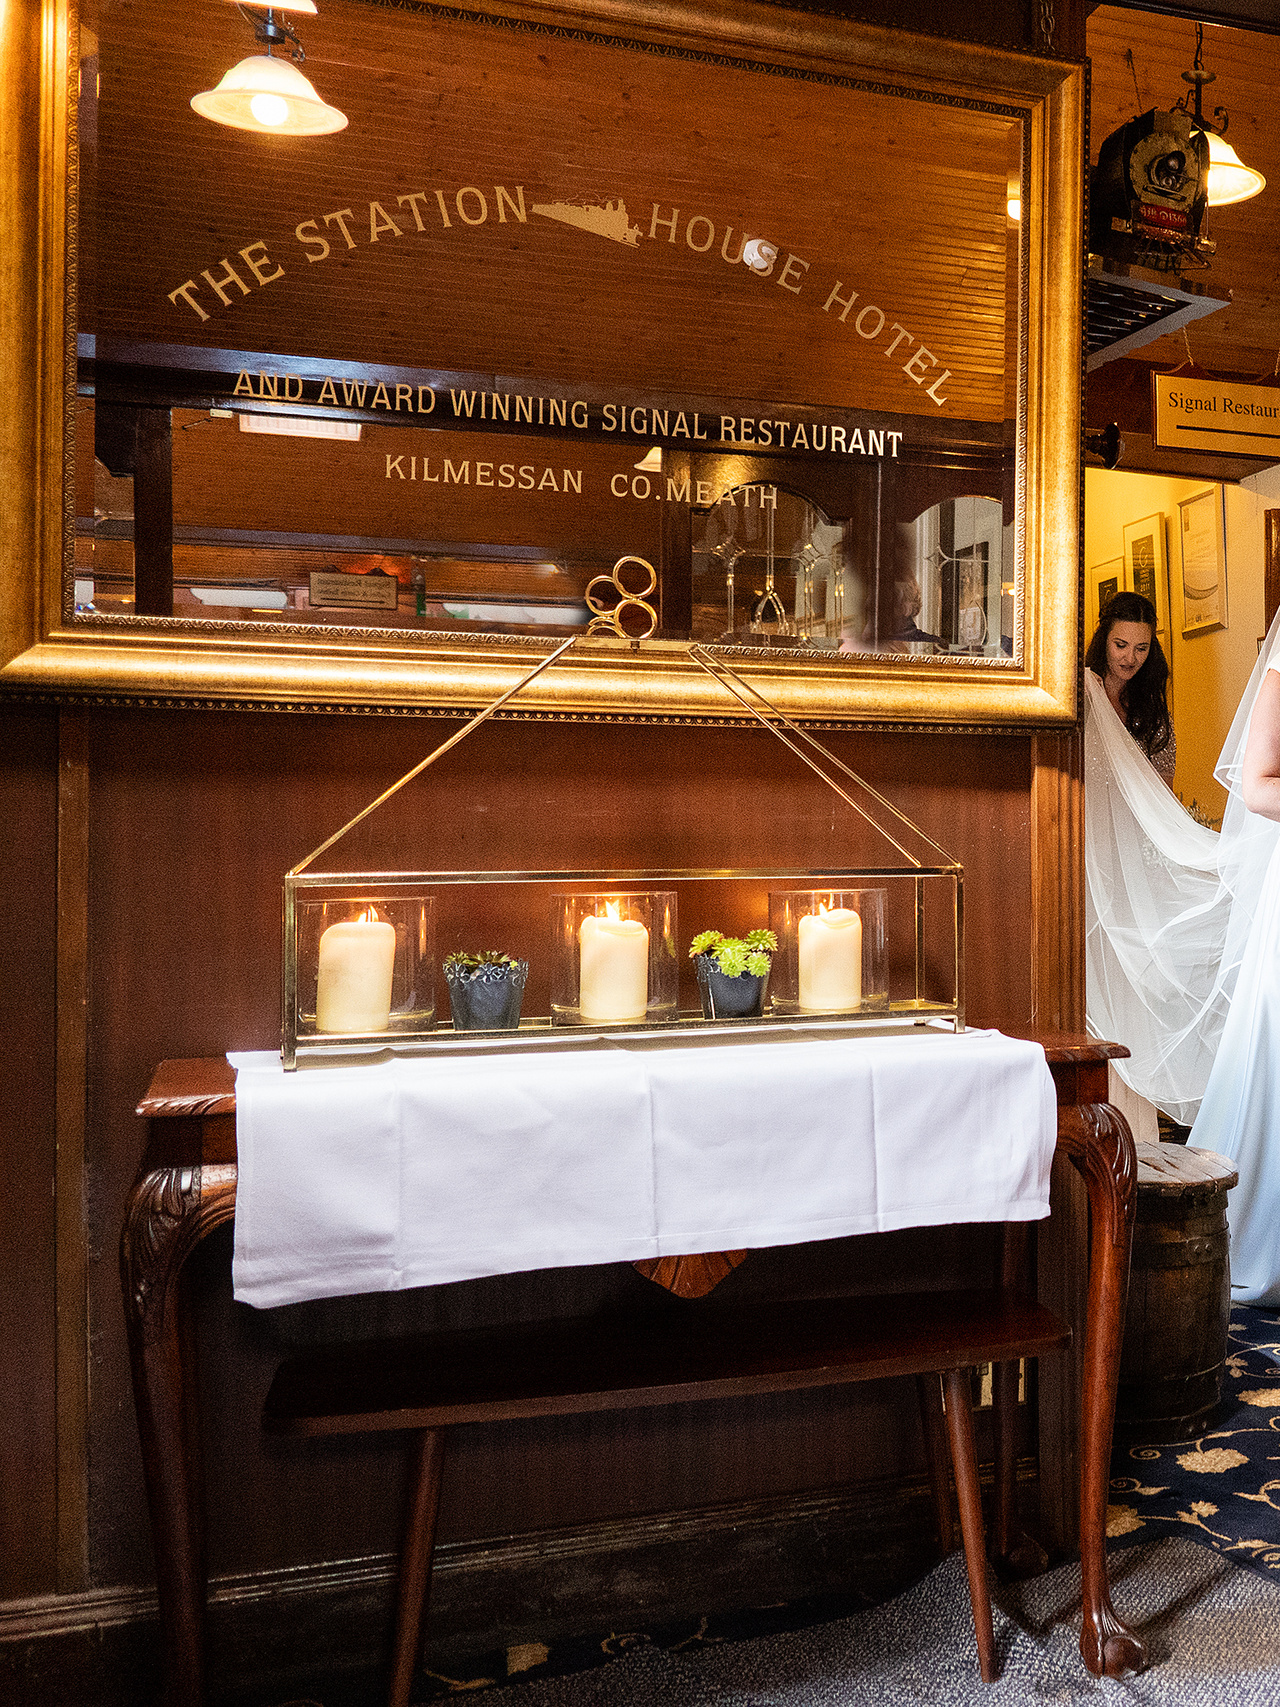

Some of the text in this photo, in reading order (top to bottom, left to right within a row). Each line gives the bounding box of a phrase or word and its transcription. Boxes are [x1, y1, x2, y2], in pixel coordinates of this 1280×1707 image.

[167, 185, 952, 407] THE STATION HOUSE HOTEL
[233, 369, 903, 458] AND AWARD WINNING SIGNAL RESTAURANT
[1168, 391, 1217, 413] Signal
[385, 454, 583, 494] KILMESSAN
